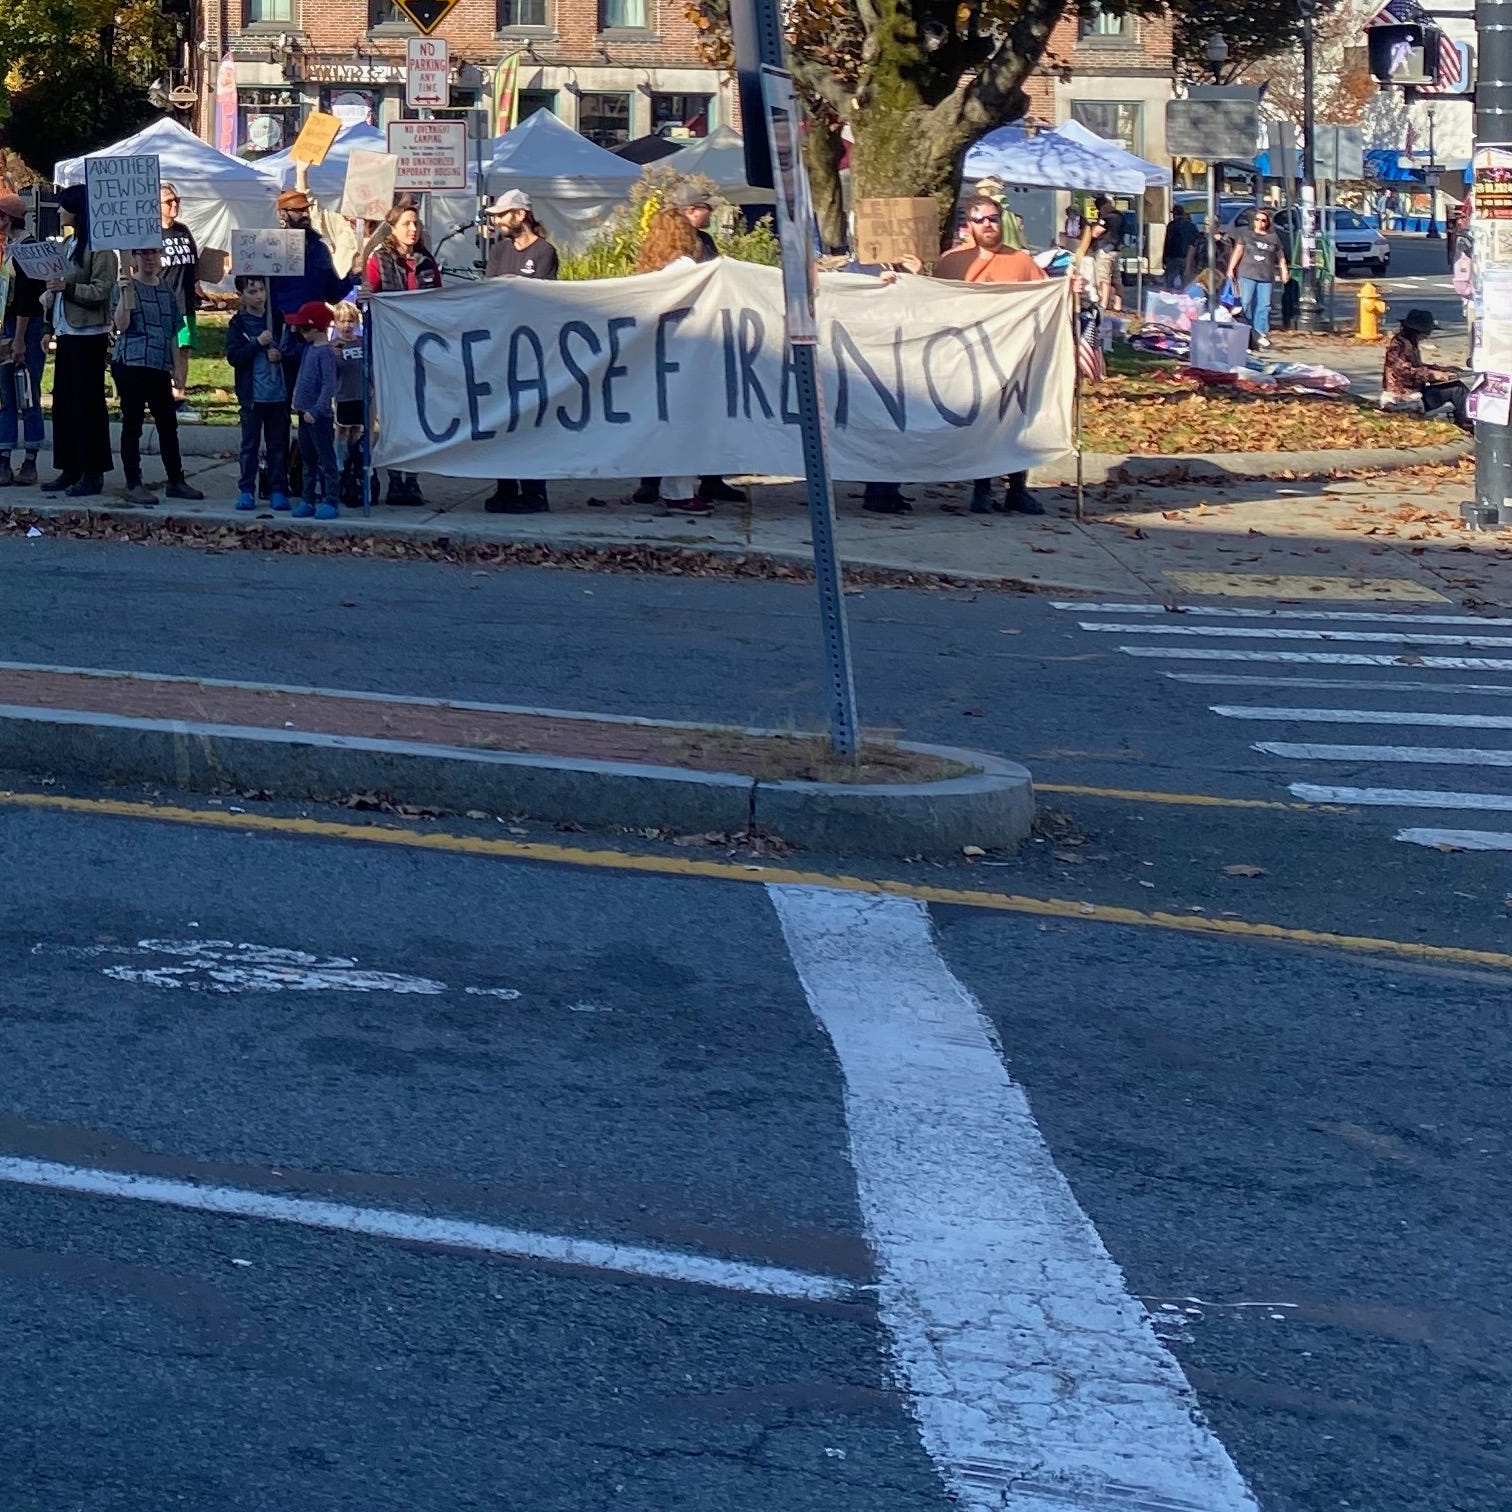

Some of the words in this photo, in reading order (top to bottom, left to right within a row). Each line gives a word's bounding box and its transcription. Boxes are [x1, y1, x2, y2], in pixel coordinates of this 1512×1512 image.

[419, 43, 435, 56] NO
[409, 59, 446, 71] PARKING
[420, 73, 435, 82] ANY
[418, 83, 438, 93] TIME
[404, 125, 413, 134] NO
[416, 125, 450, 134] OVERNIGHT
[414, 135, 442, 144] CAMPING
[89, 157, 156, 176] ANOTHER
[400, 157, 409, 166] NO
[397, 168, 431, 177] EMPORARY
[93, 176, 157, 200] JEWISH
[91, 199, 128, 218] VOICE
[135, 199, 160, 216] FOR
[92, 217, 162, 240] CEASEFIRE
[165, 244, 190, 256] OUR
[830, 308, 1041, 433] NOW
